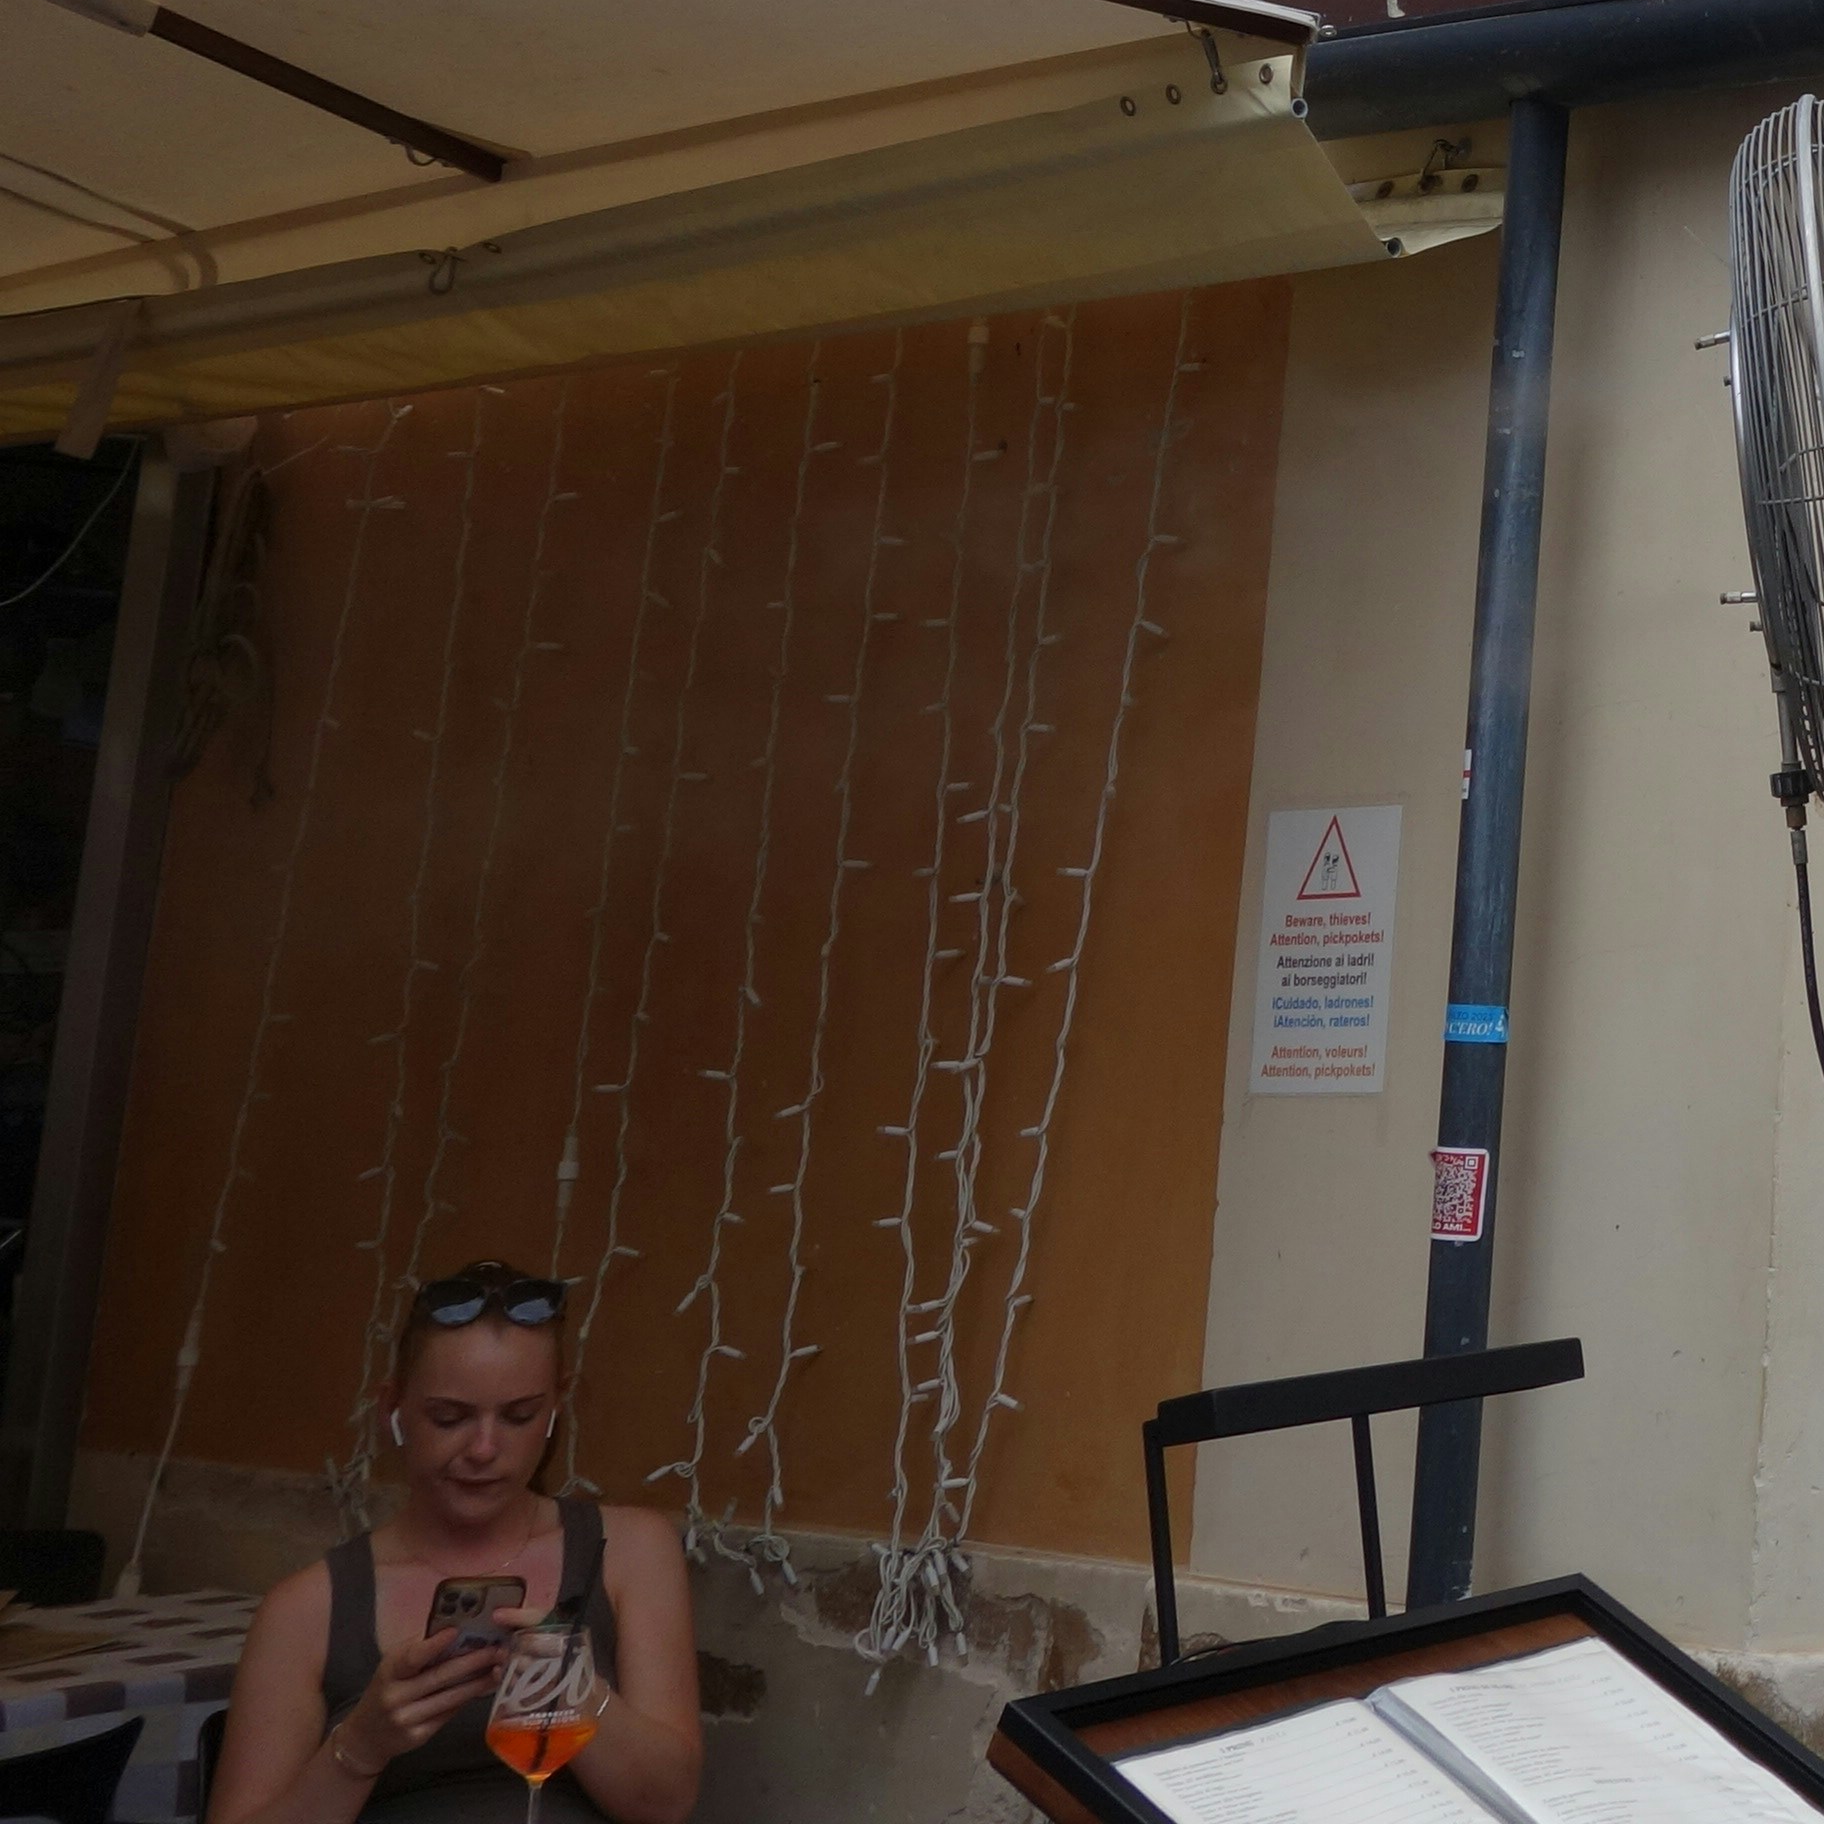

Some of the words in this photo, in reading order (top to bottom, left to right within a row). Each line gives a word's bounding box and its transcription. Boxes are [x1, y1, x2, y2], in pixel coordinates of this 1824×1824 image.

[1284, 913, 1326, 928] Beware,
[1328, 911, 1372, 927] thieves!
[1269, 932, 1321, 948] Attention,
[1322, 929, 1385, 948] pickpokets!
[1276, 953, 1333, 969] Attenzione
[1335, 953, 1345, 967] ai
[1347, 952, 1375, 967] ladri!
[1280, 973, 1291, 987] ai
[1293, 971, 1368, 990] borseggiatori!
[1323, 995, 1375, 1009] ladrones!
[1328, 1013, 1371, 1027] rateros!
[1270, 1044, 1322, 1060] Attention,
[1324, 1043, 1368, 1059] voleurs!
[1260, 1063, 1312, 1079] Attention,
[1313, 1061, 1376, 1080] pickpokets!
